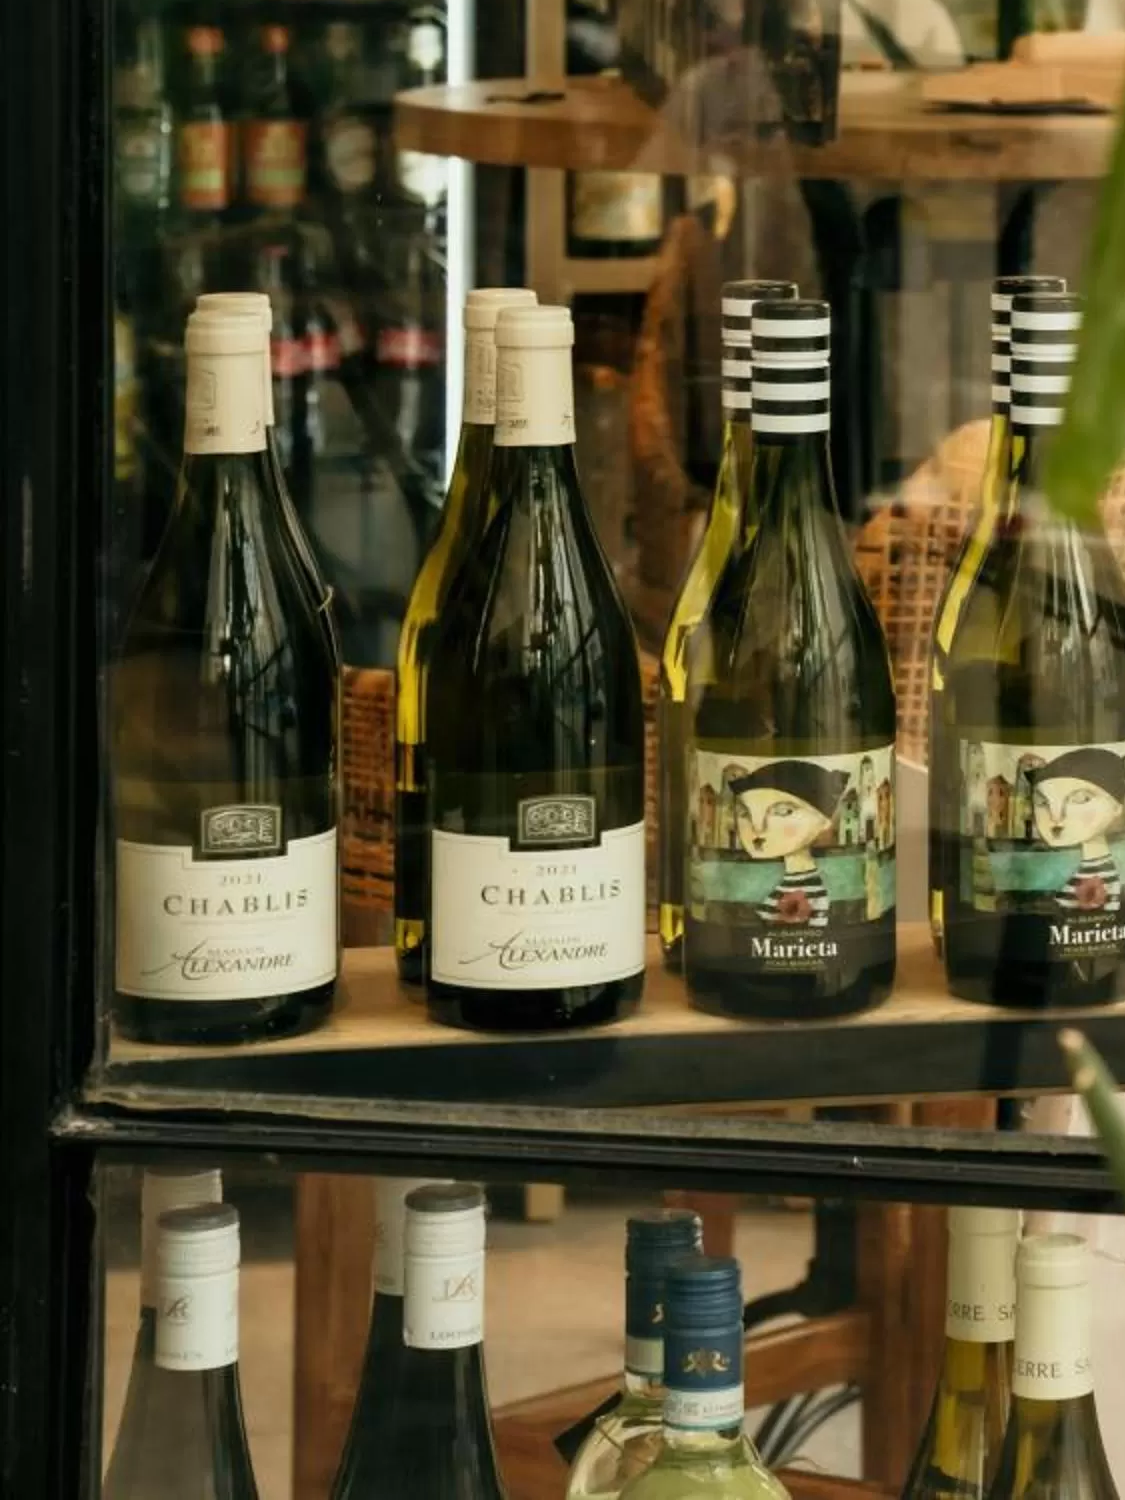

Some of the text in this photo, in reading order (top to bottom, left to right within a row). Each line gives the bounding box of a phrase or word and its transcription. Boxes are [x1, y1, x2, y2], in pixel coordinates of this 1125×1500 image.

[163, 888, 309, 917] CHABLIS
[480, 878, 622, 906] CHABLIS
[139, 938, 294, 981] ALEXANDRE
[457, 931, 608, 971] ALEXANDRE
[751, 937, 838, 958] Marieta
